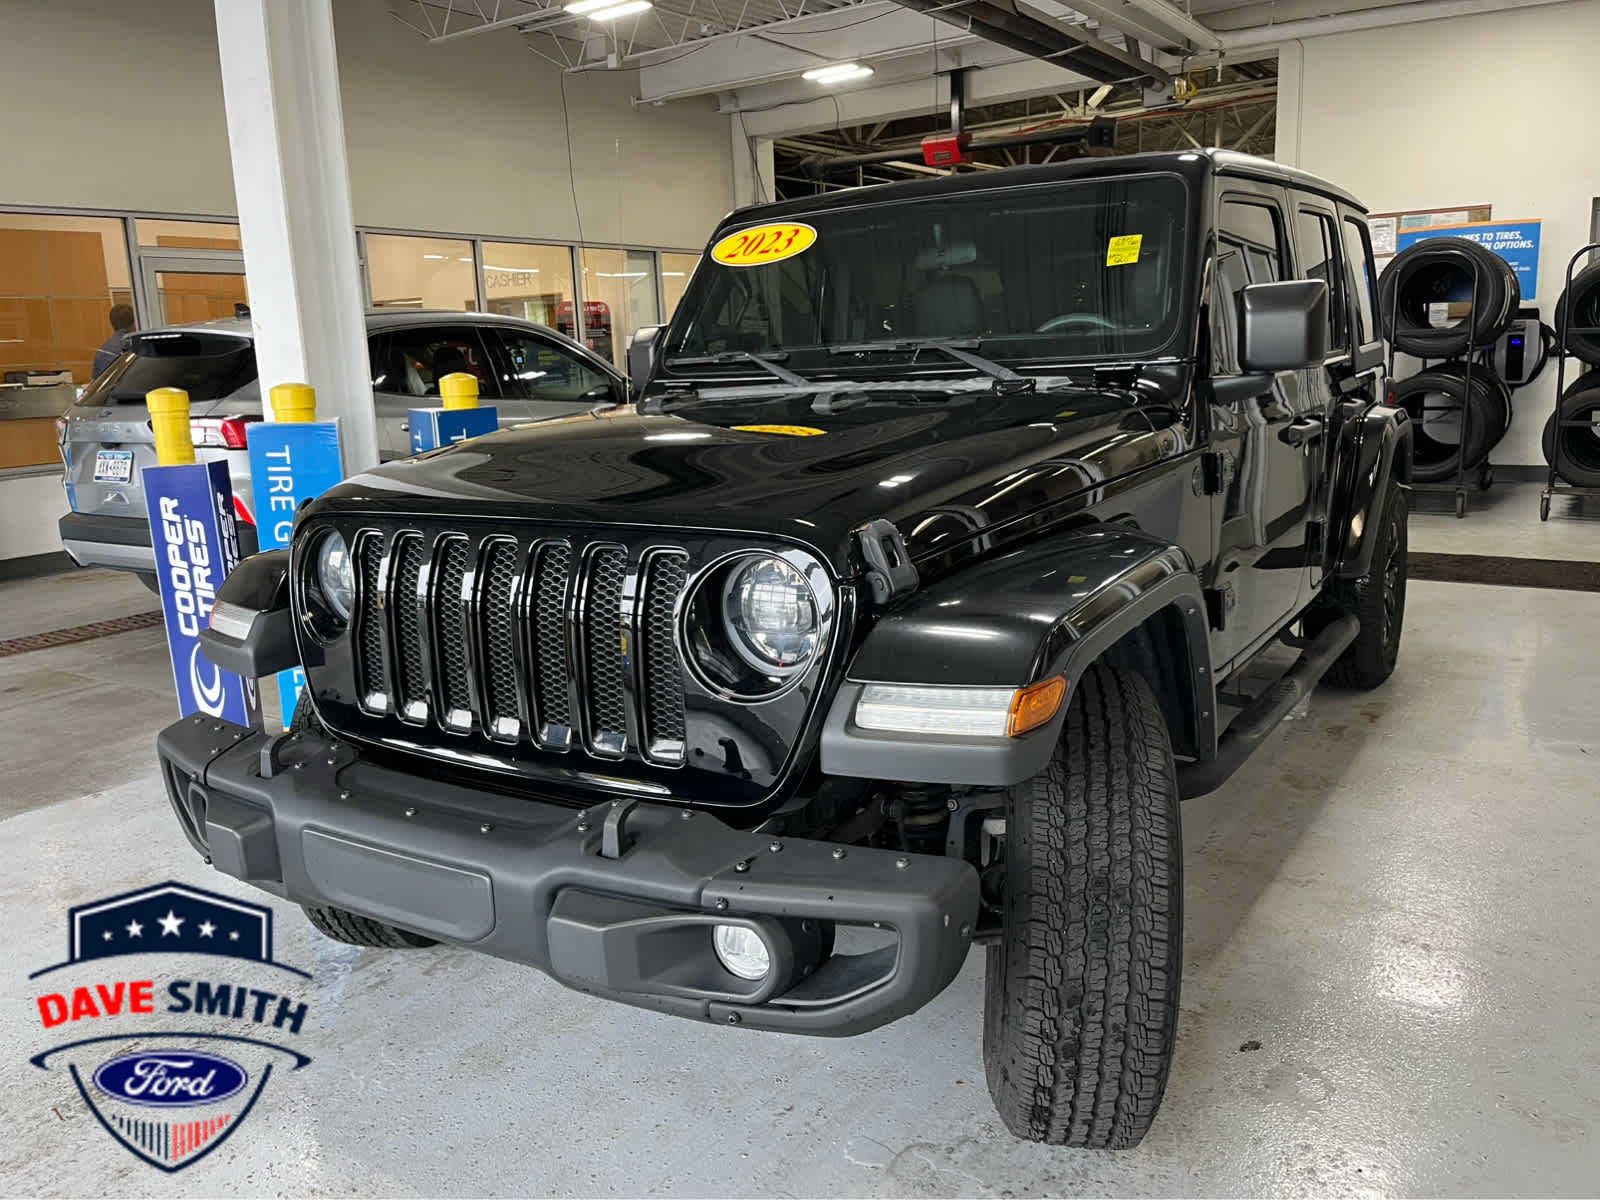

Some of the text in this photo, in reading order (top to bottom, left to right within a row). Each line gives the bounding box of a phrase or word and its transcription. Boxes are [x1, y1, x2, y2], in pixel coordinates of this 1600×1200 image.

[725, 228, 800, 259] 2023
[1482, 232, 1494, 241] TO
[1493, 240, 1535, 250] OPTIONS.
[487, 271, 532, 289] CASHIER
[265, 444, 296, 512] TIRE
[160, 496, 200, 638] COOPER
[185, 519, 216, 618] TIRES
